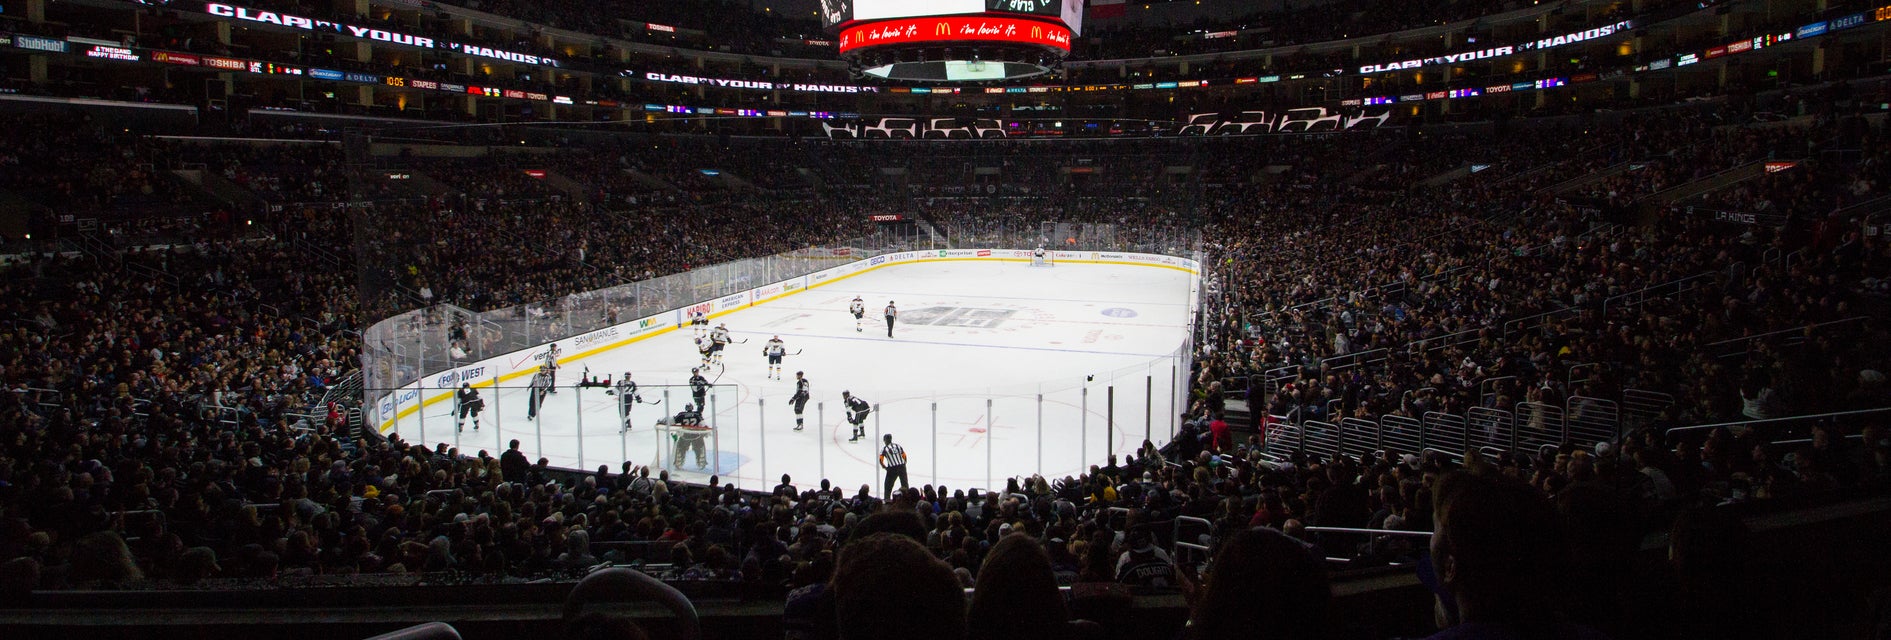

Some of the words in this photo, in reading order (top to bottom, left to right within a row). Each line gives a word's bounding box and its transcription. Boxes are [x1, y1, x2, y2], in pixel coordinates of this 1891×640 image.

[649, 23, 674, 33] TOSHIBA
[1836, 15, 1864, 28] DELTA
[960, 24, 975, 34] i'm
[977, 22, 1003, 35] lovin'
[18, 36, 65, 53] StubHub!
[347, 25, 434, 48] YOUR
[464, 44, 539, 65] HANDS
[1443, 45, 1513, 63] YOUR
[1537, 25, 1613, 49] HANDS
[1727, 40, 1752, 53] TOSHIBA
[110, 53, 139, 61] BIRTHDAY
[203, 57, 246, 70] TOSHIBA
[353, 75, 378, 83] DELTA
[412, 80, 437, 89] STAPLES
[716, 78, 773, 90] YOUR
[794, 83, 858, 93] HANDS
[1485, 84, 1511, 93] TOYOTA
[527, 92, 548, 100] TOYOTA
[1715, 210, 1727, 221] LA
[1728, 211, 1756, 224] KINGS
[870, 255, 886, 266] GEICO
[722, 293, 744, 303] AMERICAN
[721, 300, 741, 310] EXPRESS
[575, 336, 590, 346] SAN
[593, 327, 619, 342] MANUEL
[461, 366, 486, 381] WEST
[398, 386, 425, 406] LIGH
